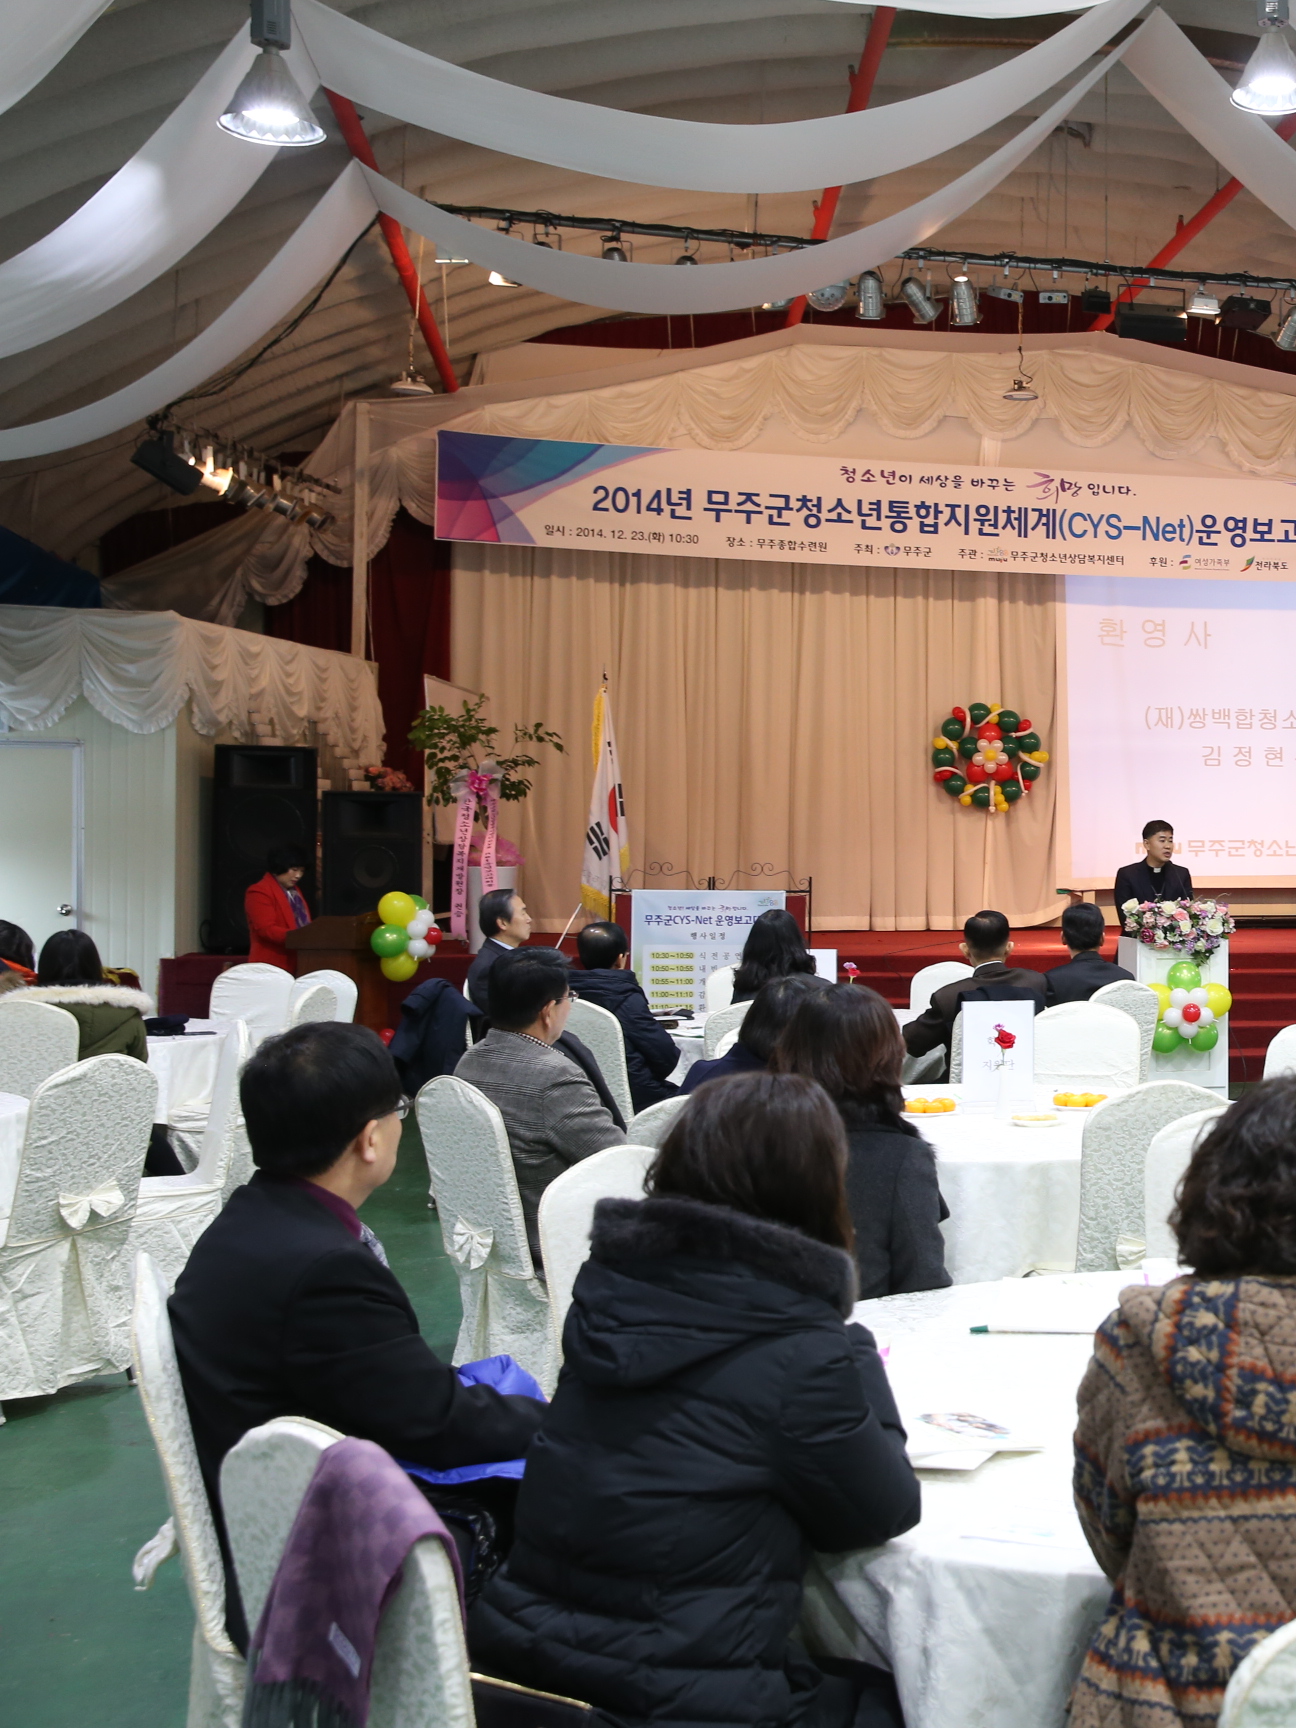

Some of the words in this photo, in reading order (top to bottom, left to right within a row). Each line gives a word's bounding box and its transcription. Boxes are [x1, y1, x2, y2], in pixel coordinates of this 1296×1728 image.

[840, 466, 912, 486] 청소년이
[919, 474, 965, 489] 세상을
[970, 478, 1016, 492] 바꾸는
[592, 485, 693, 520] 2014년
[544, 524, 566, 536] 일시
[576, 527, 607, 538] 2014.
[610, 530, 627, 540] 12.
[631, 530, 665, 544] 23.(화)
[669, 533, 699, 544] 10:30
[726, 536, 750, 548] 장소
[756, 538, 828, 552] 무주종합수련원
[854, 544, 874, 554] 주최
[902, 546, 932, 558] 무주군
[958, 548, 978, 560] 주관
[1010, 550, 1124, 566] 무주군청소년상담복지센터
[1149, 556, 1168, 567] 후원
[1194, 558, 1230, 567] 여성가족부
[1255, 561, 1289, 571] 전라북도
[644, 914, 713, 926] 무주군CYS-Net
[715, 915, 760, 926] 운영보고
